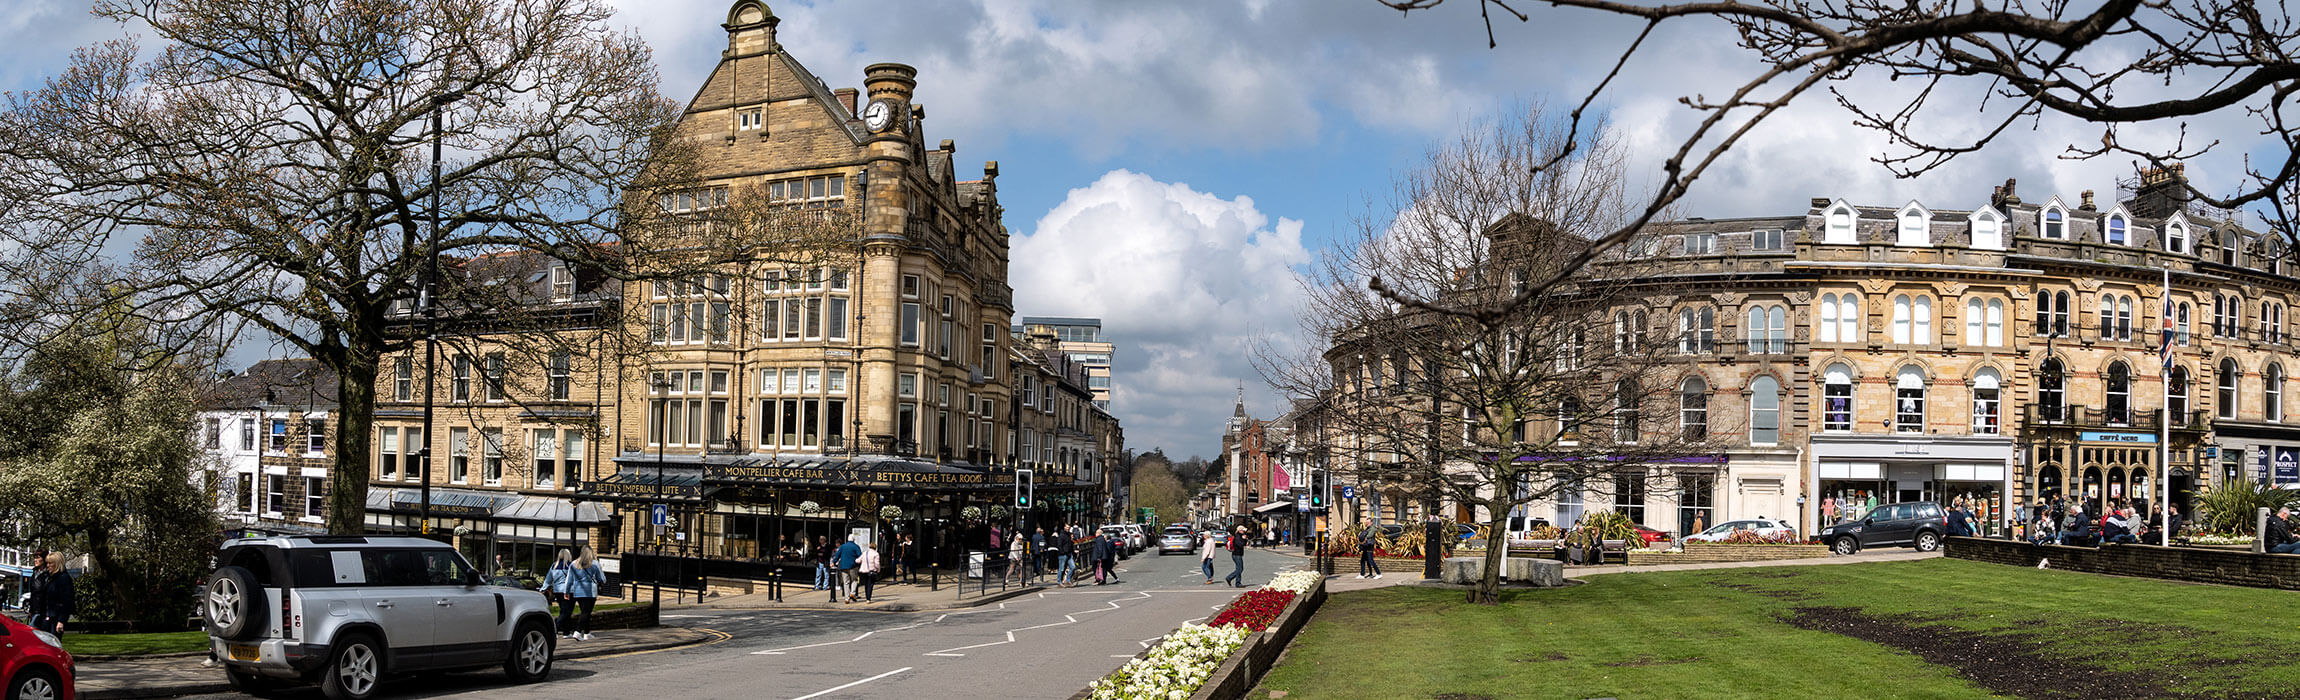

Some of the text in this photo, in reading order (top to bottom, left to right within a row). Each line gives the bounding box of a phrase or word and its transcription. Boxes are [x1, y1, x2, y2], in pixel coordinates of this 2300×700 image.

[725, 467, 824, 479] MONTPELLIER CAFE BAR
[877, 472, 982, 483] BETTYS CAFE TEA ROOMS
[596, 484, 679, 494] BETTYS IMPERIAL UITE
